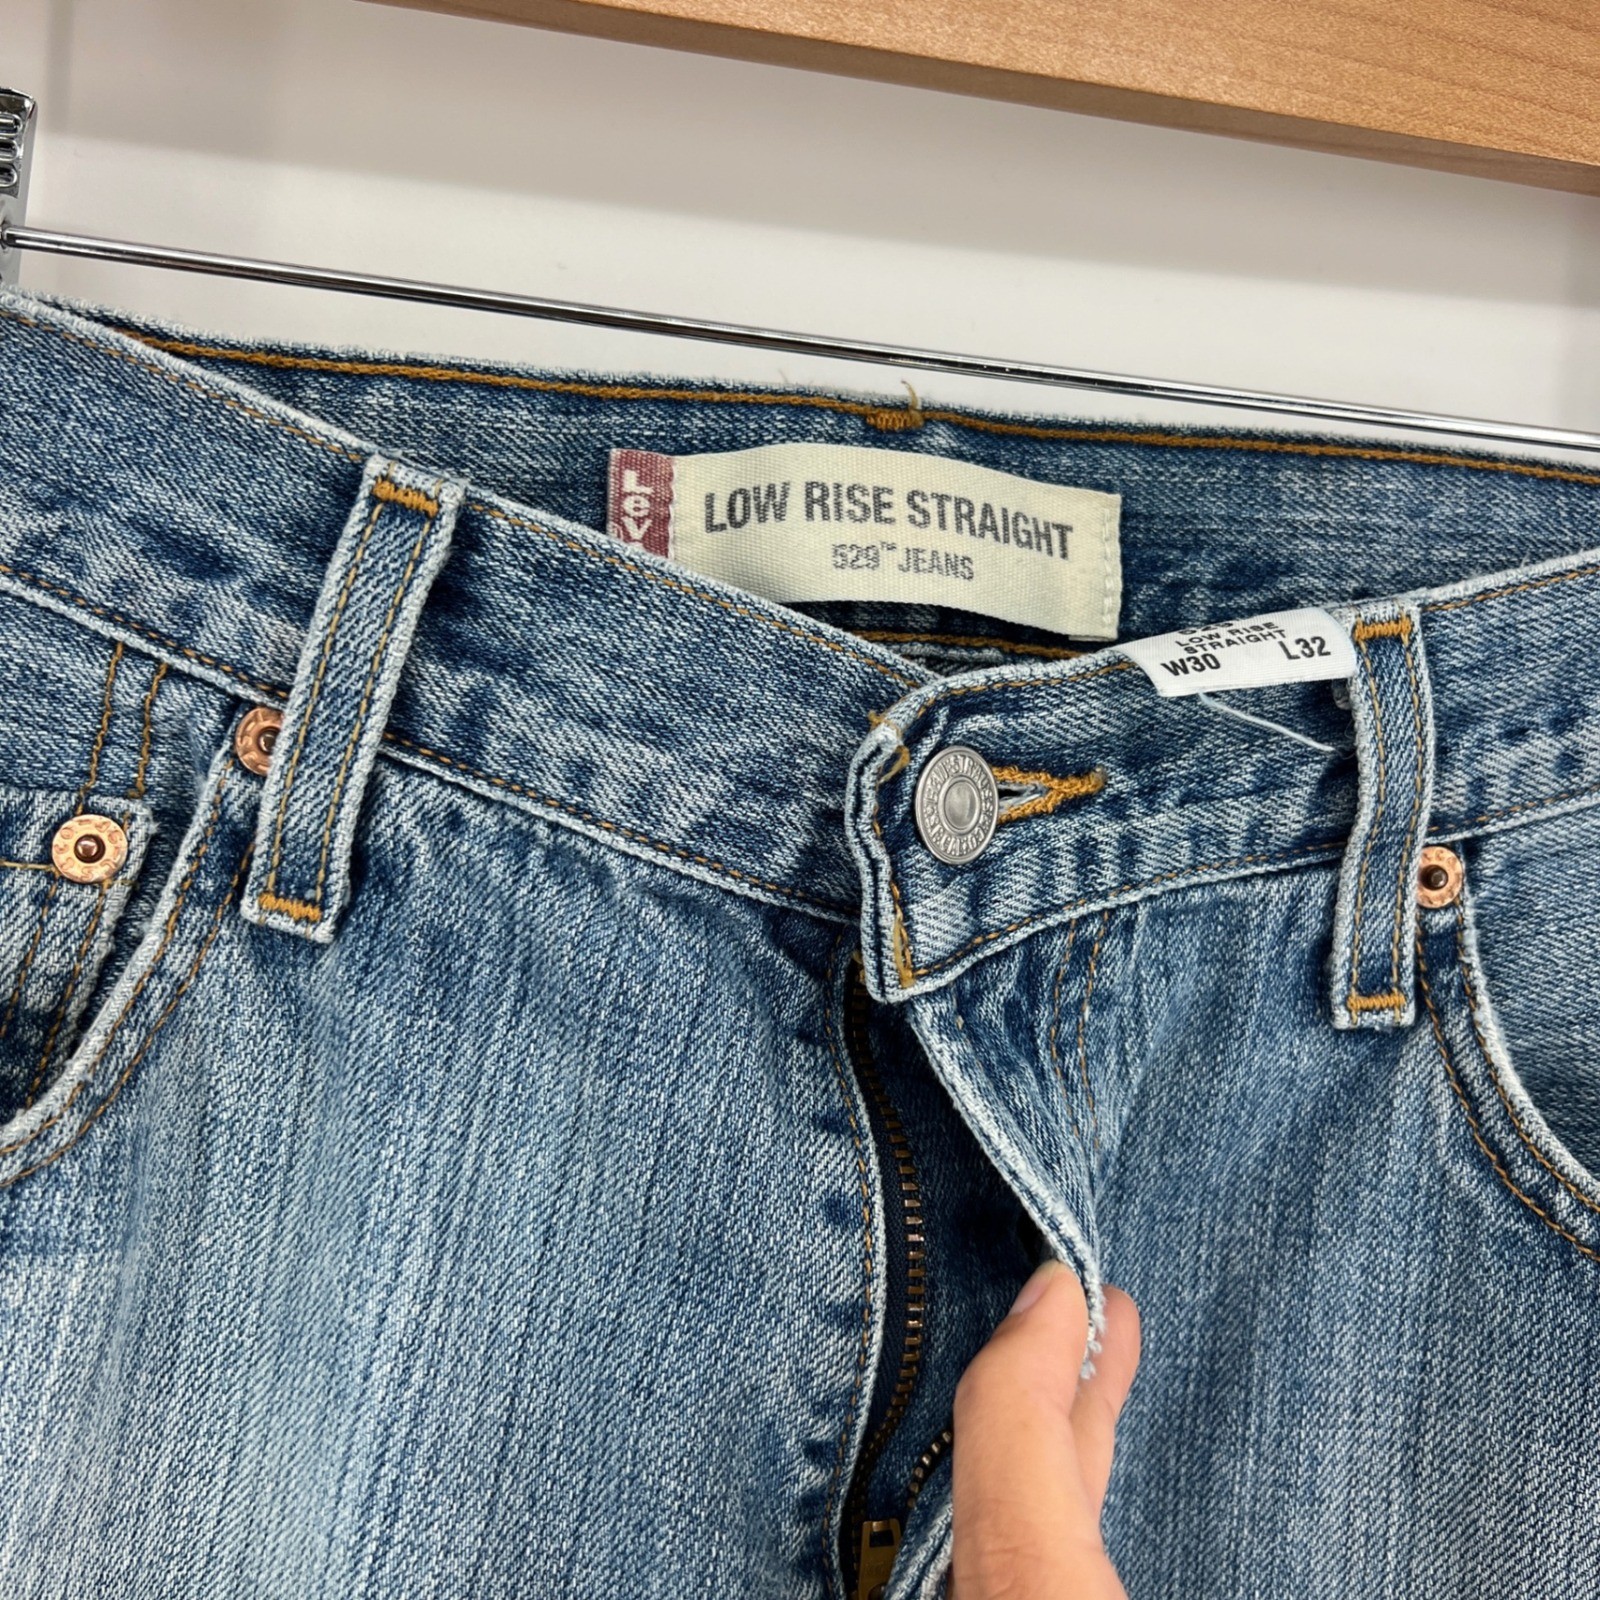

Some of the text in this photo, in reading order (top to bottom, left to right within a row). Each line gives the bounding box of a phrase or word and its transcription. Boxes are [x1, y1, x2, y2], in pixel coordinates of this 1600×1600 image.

[621, 469, 655, 546] Lev
[704, 481, 1073, 560] LOW RISE STRAIGHT
[898, 547, 974, 581] JEANS
[1175, 621, 1279, 647] LOW RISE
[1183, 629, 1286, 654] STRAIGHT
[1160, 636, 1331, 676] W30 L32
